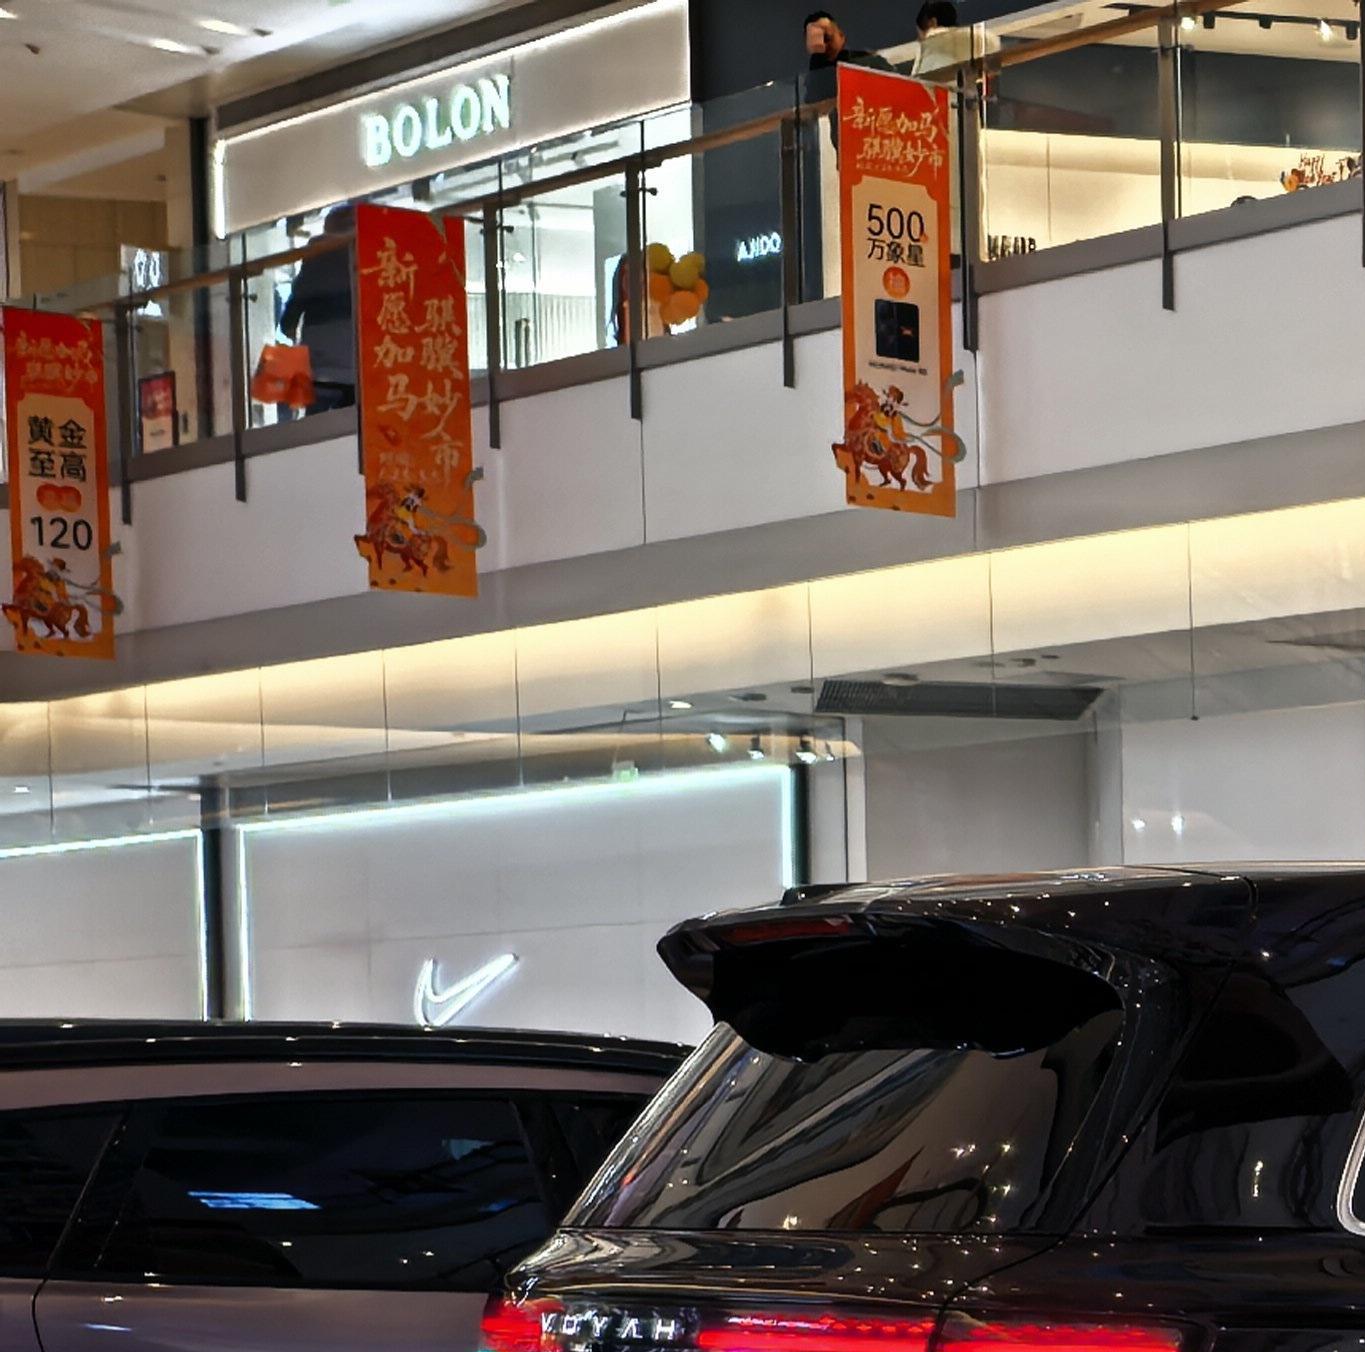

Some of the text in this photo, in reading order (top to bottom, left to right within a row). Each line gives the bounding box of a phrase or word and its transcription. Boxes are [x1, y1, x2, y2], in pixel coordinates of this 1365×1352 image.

[362, 74, 511, 167] BOLON
[867, 203, 925, 243] 500
[867, 237, 926, 268] 万象星
[27, 417, 88, 450] 黄金
[27, 450, 88, 483] 至高
[30, 516, 94, 551] 120
[541, 1311, 676, 1342] VOYAH
